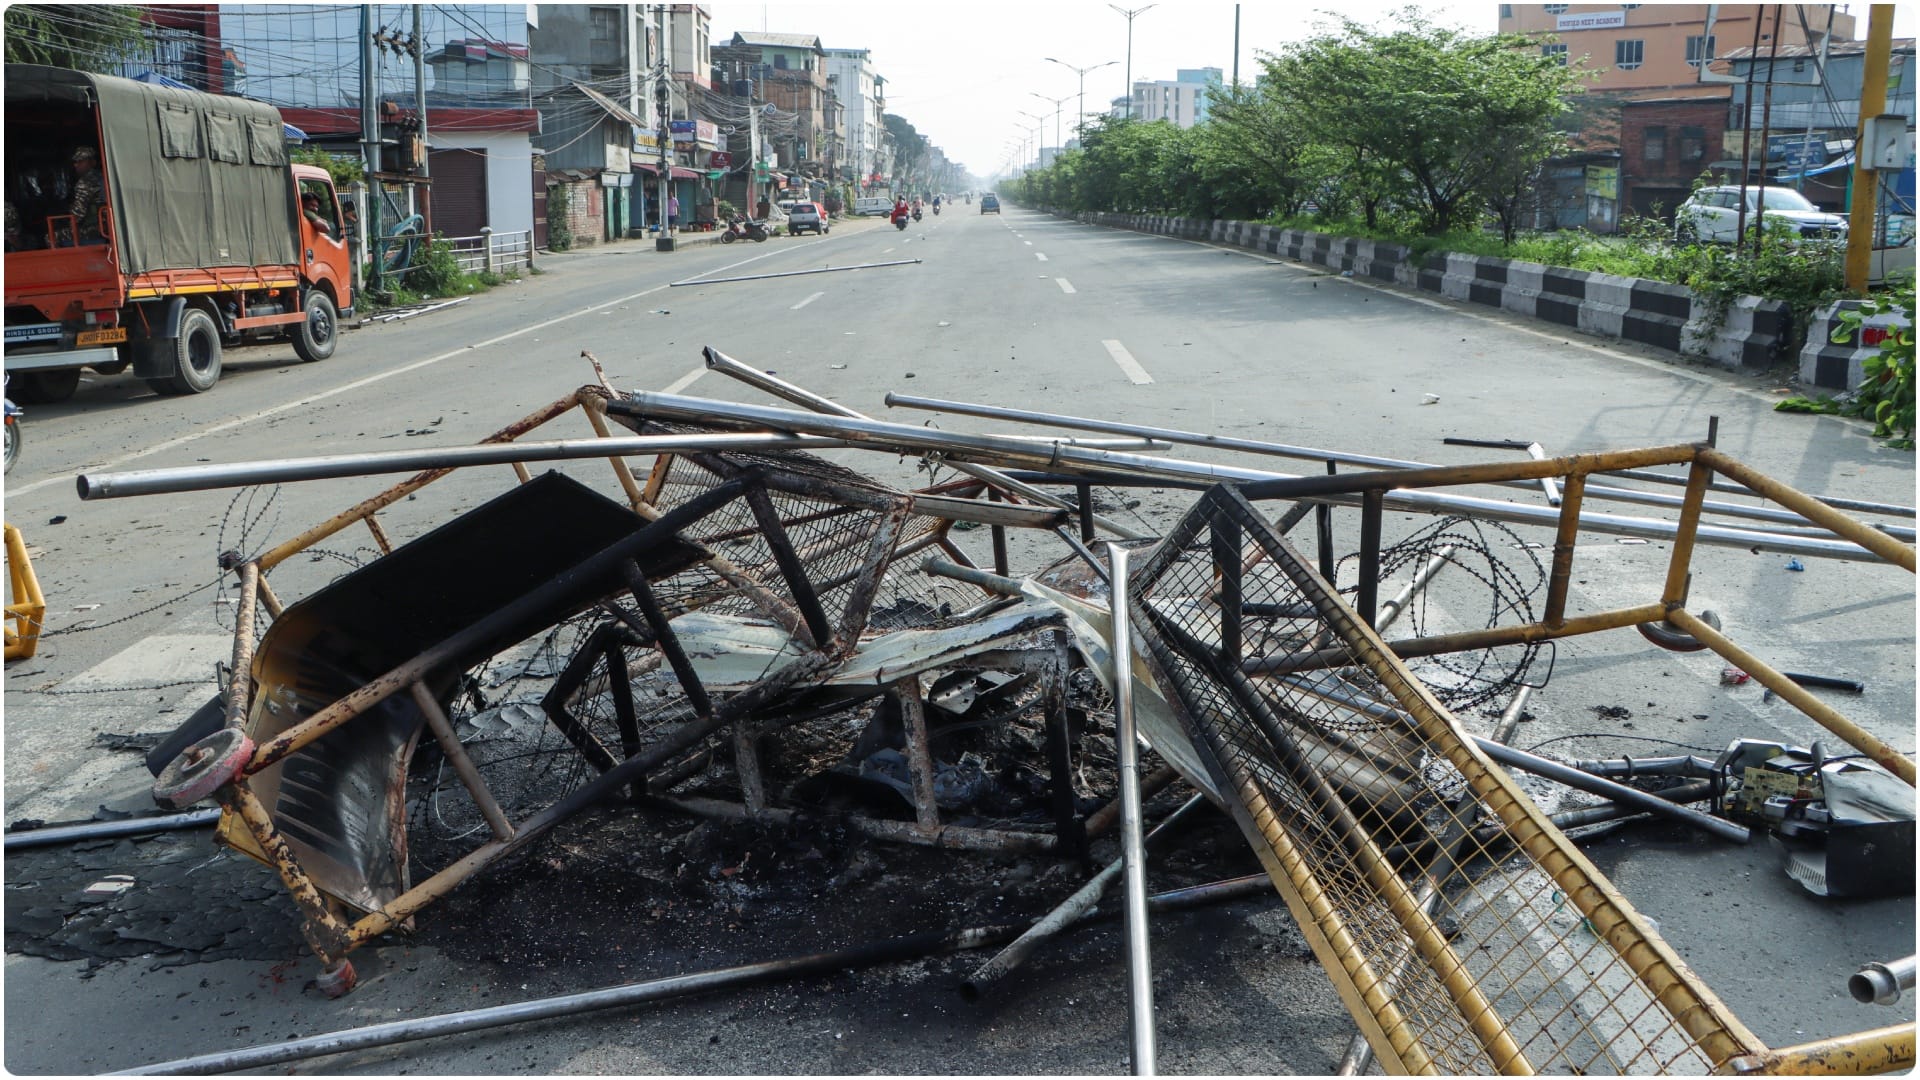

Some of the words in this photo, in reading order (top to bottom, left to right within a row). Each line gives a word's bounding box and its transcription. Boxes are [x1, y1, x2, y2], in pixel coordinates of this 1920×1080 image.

[1581, 18, 1594, 26] NEET
[1596, 17, 1621, 25] ACADEMY
[6, 329, 35, 337] HINDUJA
[37, 327, 60, 335] GROUP
